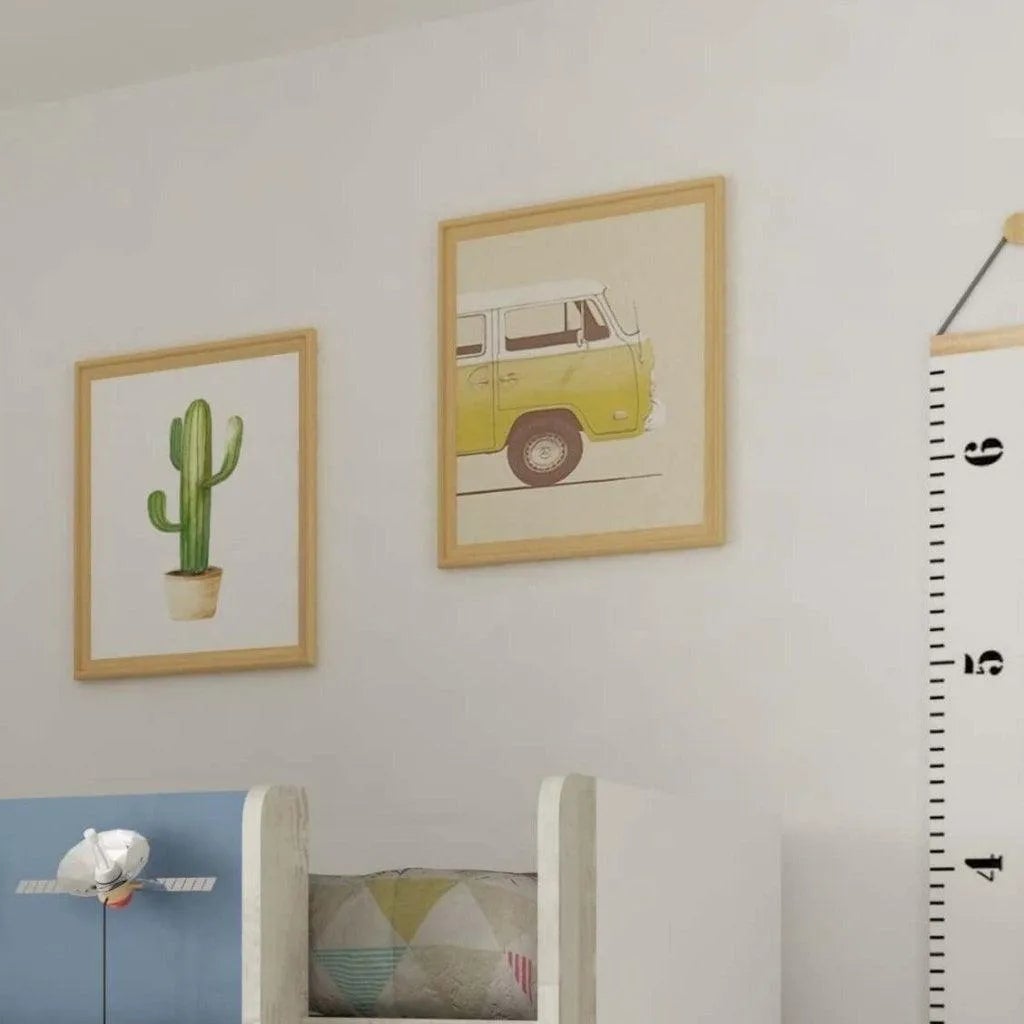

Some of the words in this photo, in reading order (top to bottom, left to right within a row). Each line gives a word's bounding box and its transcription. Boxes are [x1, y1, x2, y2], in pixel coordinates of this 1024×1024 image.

[964, 437, 1004, 467] 6
[964, 649, 1004, 676] 5
[964, 854, 1004, 882] 4
